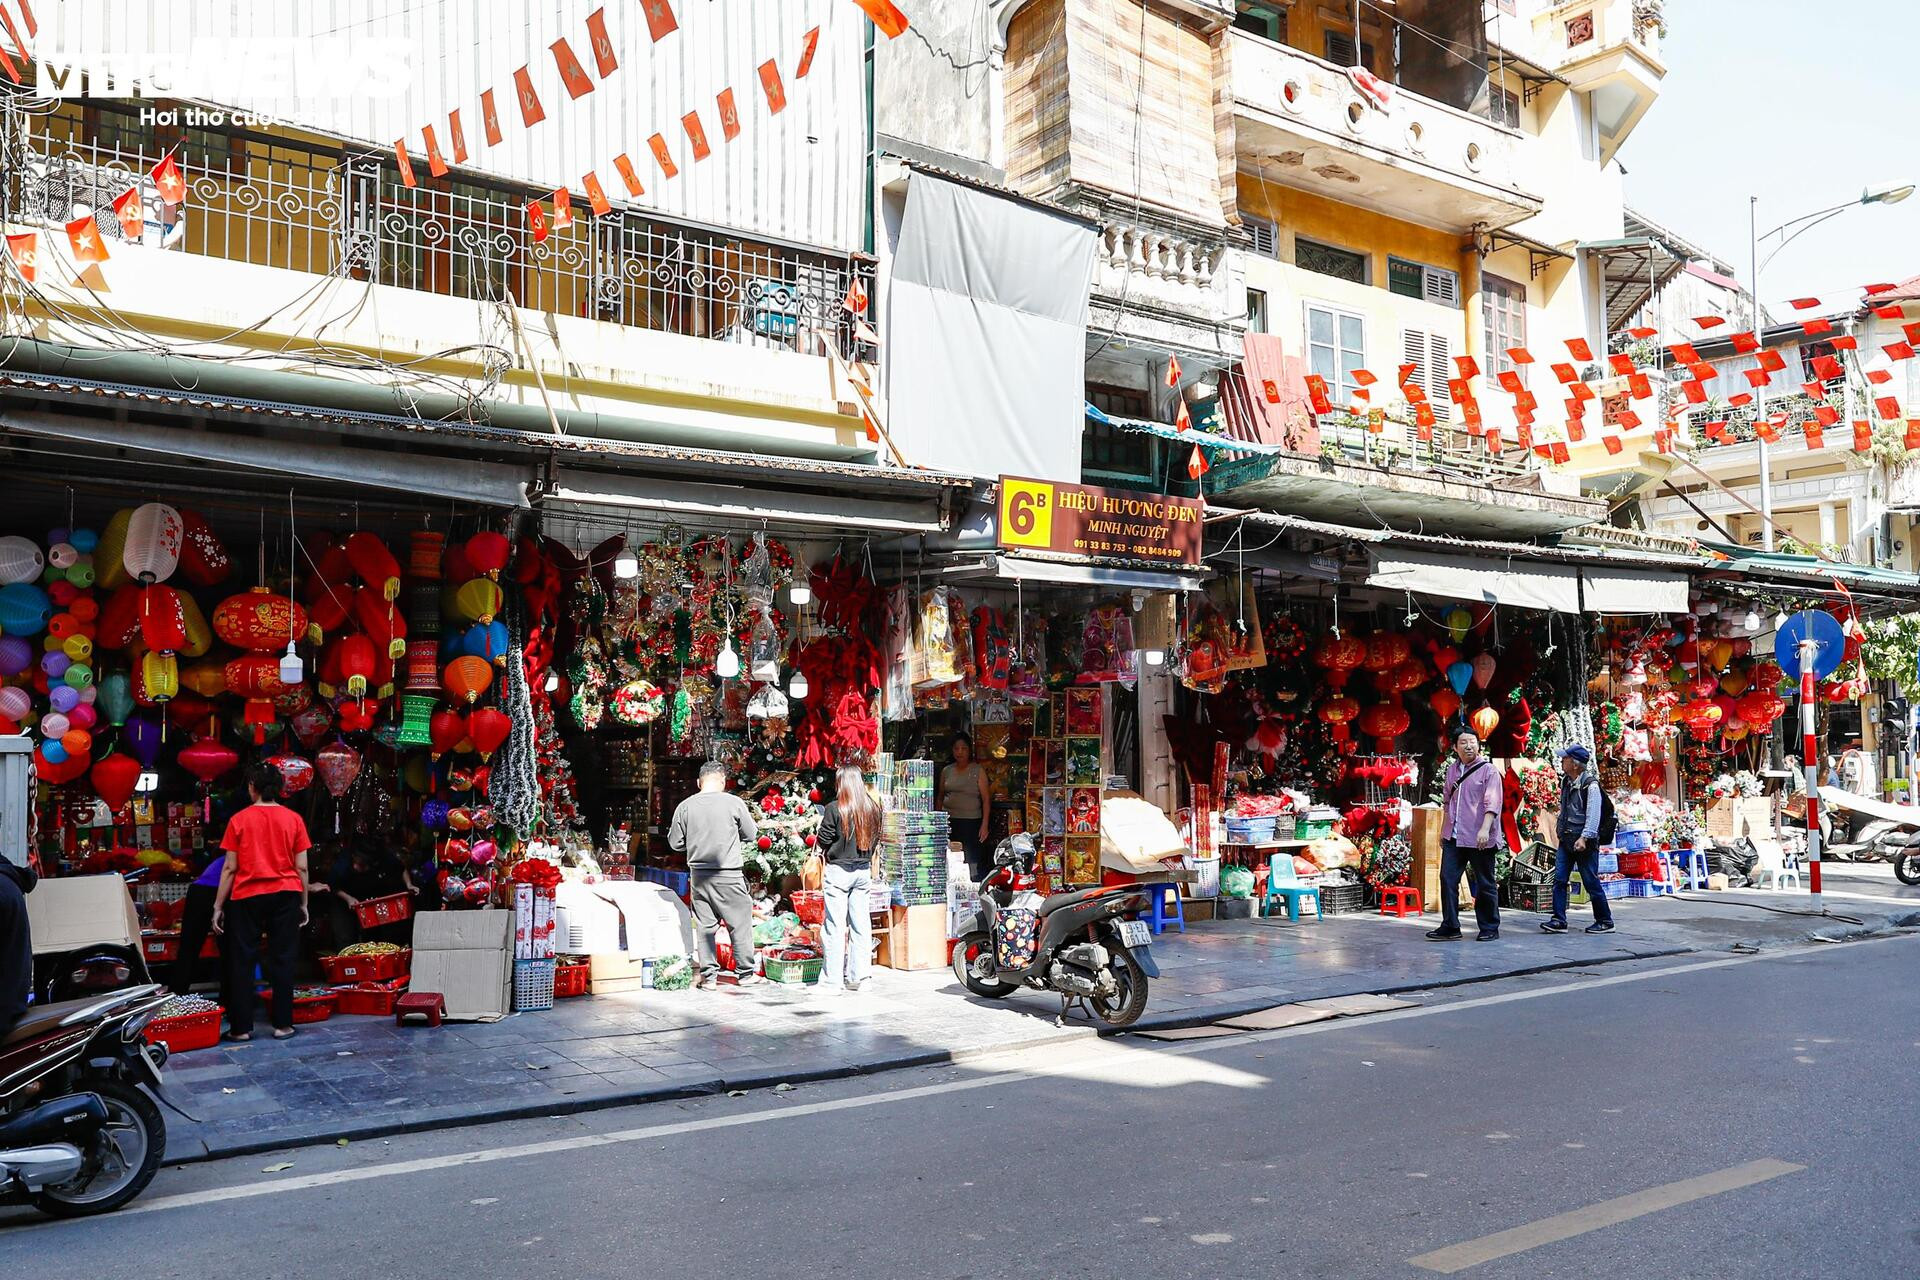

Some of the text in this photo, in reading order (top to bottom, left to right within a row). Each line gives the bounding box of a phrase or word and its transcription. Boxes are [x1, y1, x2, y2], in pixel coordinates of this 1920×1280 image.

[1058, 490, 1198, 523] HIỆU HƯƠNG ĐEN
[1088, 519, 1169, 541] MINH NGUYỆT
[1073, 539, 1088, 549] 091
[1089, 541, 1099, 550] 33
[1101, 542, 1111, 551] 83
[1112, 543, 1126, 552] 753
[1132, 545, 1147, 555] 082
